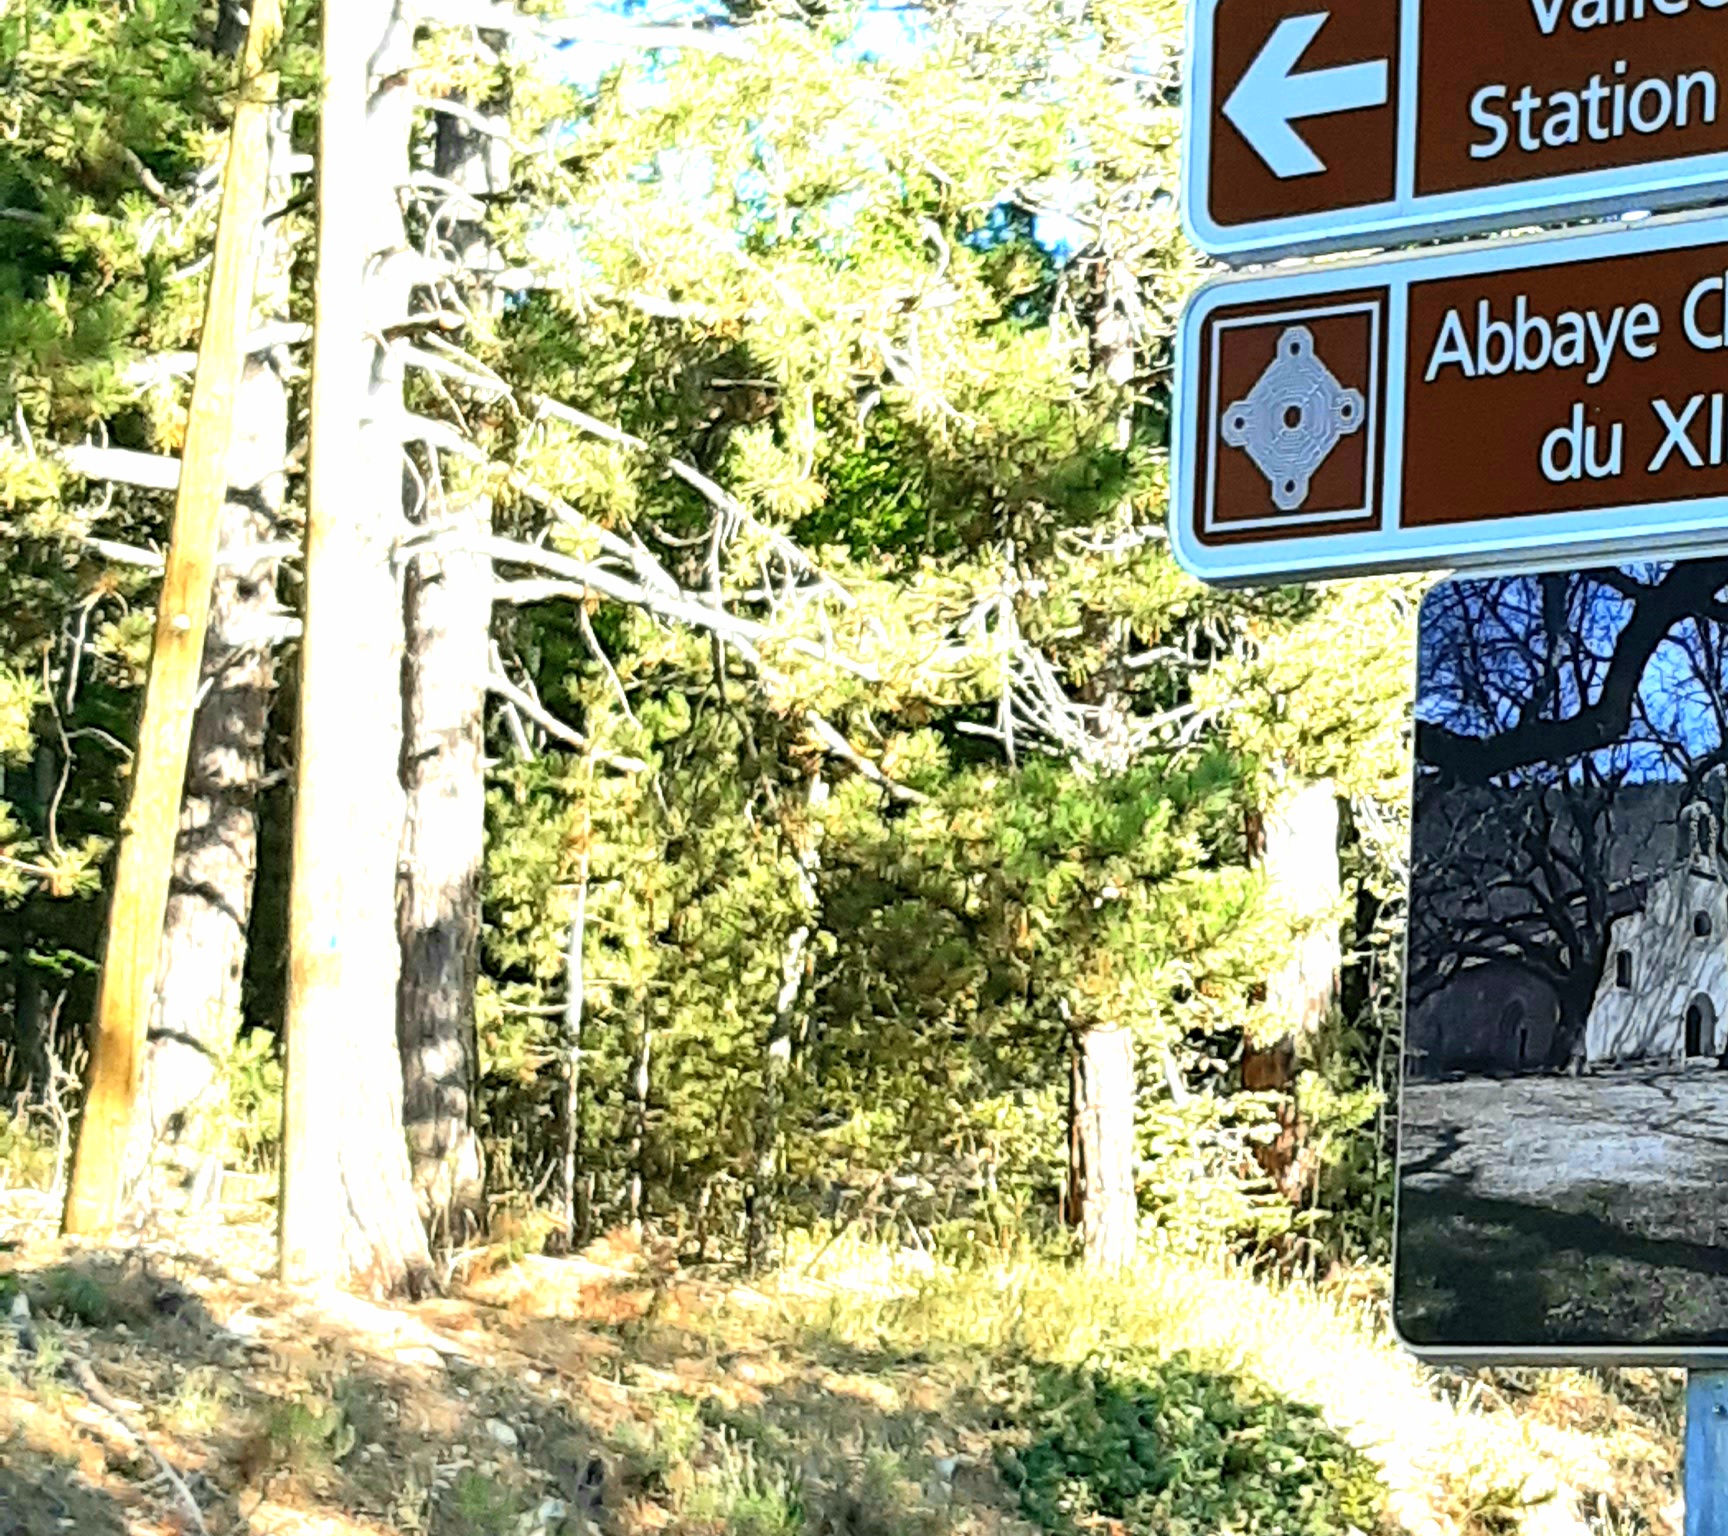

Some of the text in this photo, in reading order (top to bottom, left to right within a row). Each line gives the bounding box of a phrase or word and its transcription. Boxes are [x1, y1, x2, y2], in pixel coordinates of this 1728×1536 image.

[1469, 59, 1717, 159] Station
[1424, 294, 1661, 385] Abbaye
[1540, 401, 1624, 483] du
